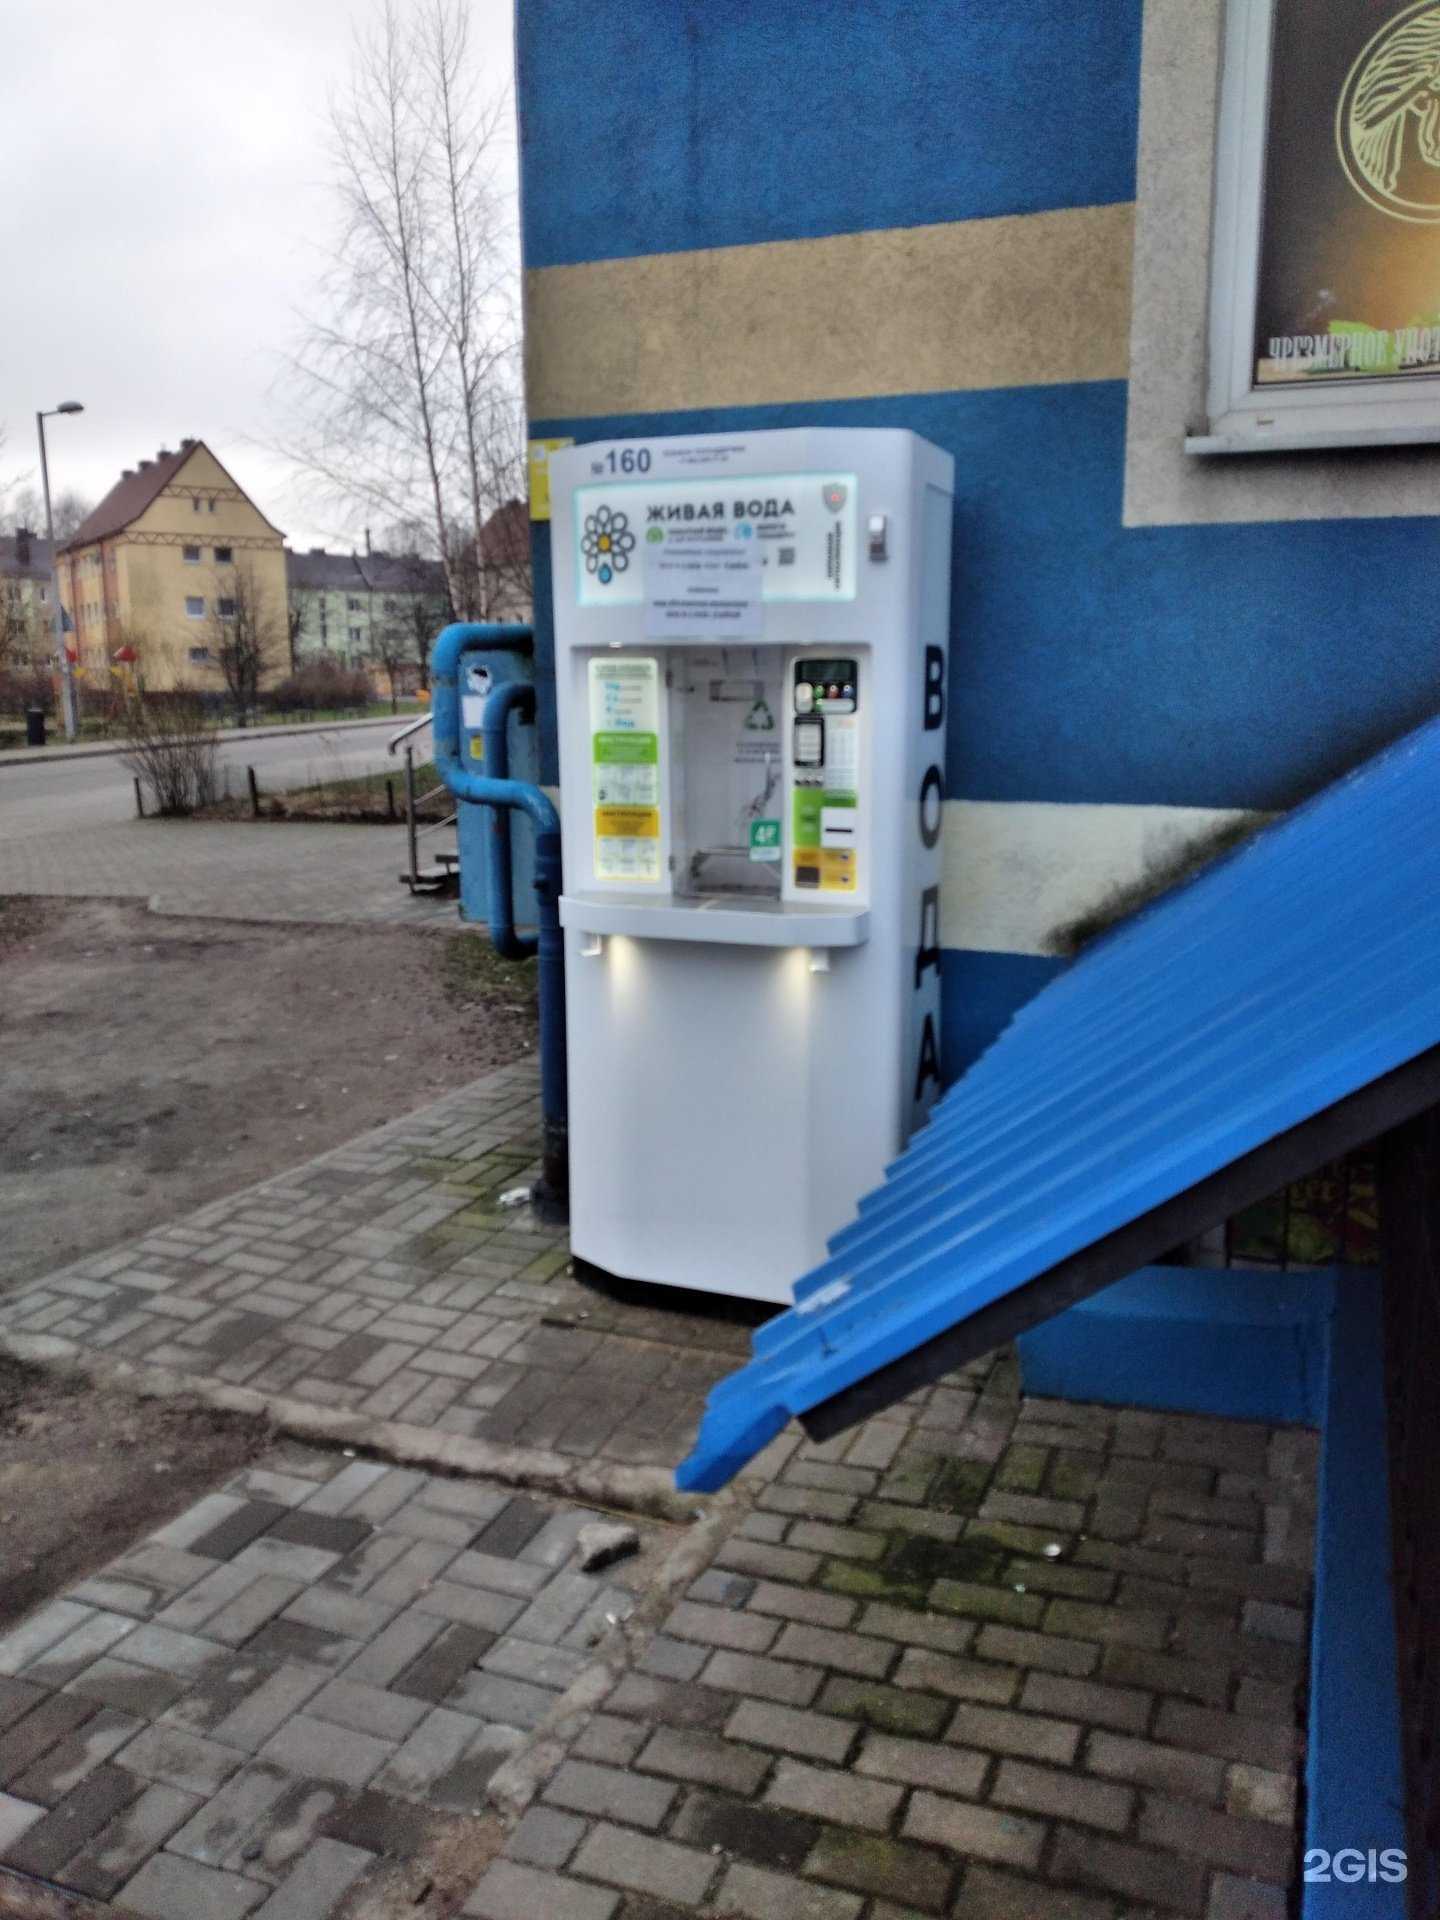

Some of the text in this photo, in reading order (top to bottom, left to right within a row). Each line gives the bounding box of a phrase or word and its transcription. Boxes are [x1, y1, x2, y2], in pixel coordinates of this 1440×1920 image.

[647, 498, 795, 521] ЖИВАЯ ВОДА
[914, 645, 944, 1102] ВОДА
